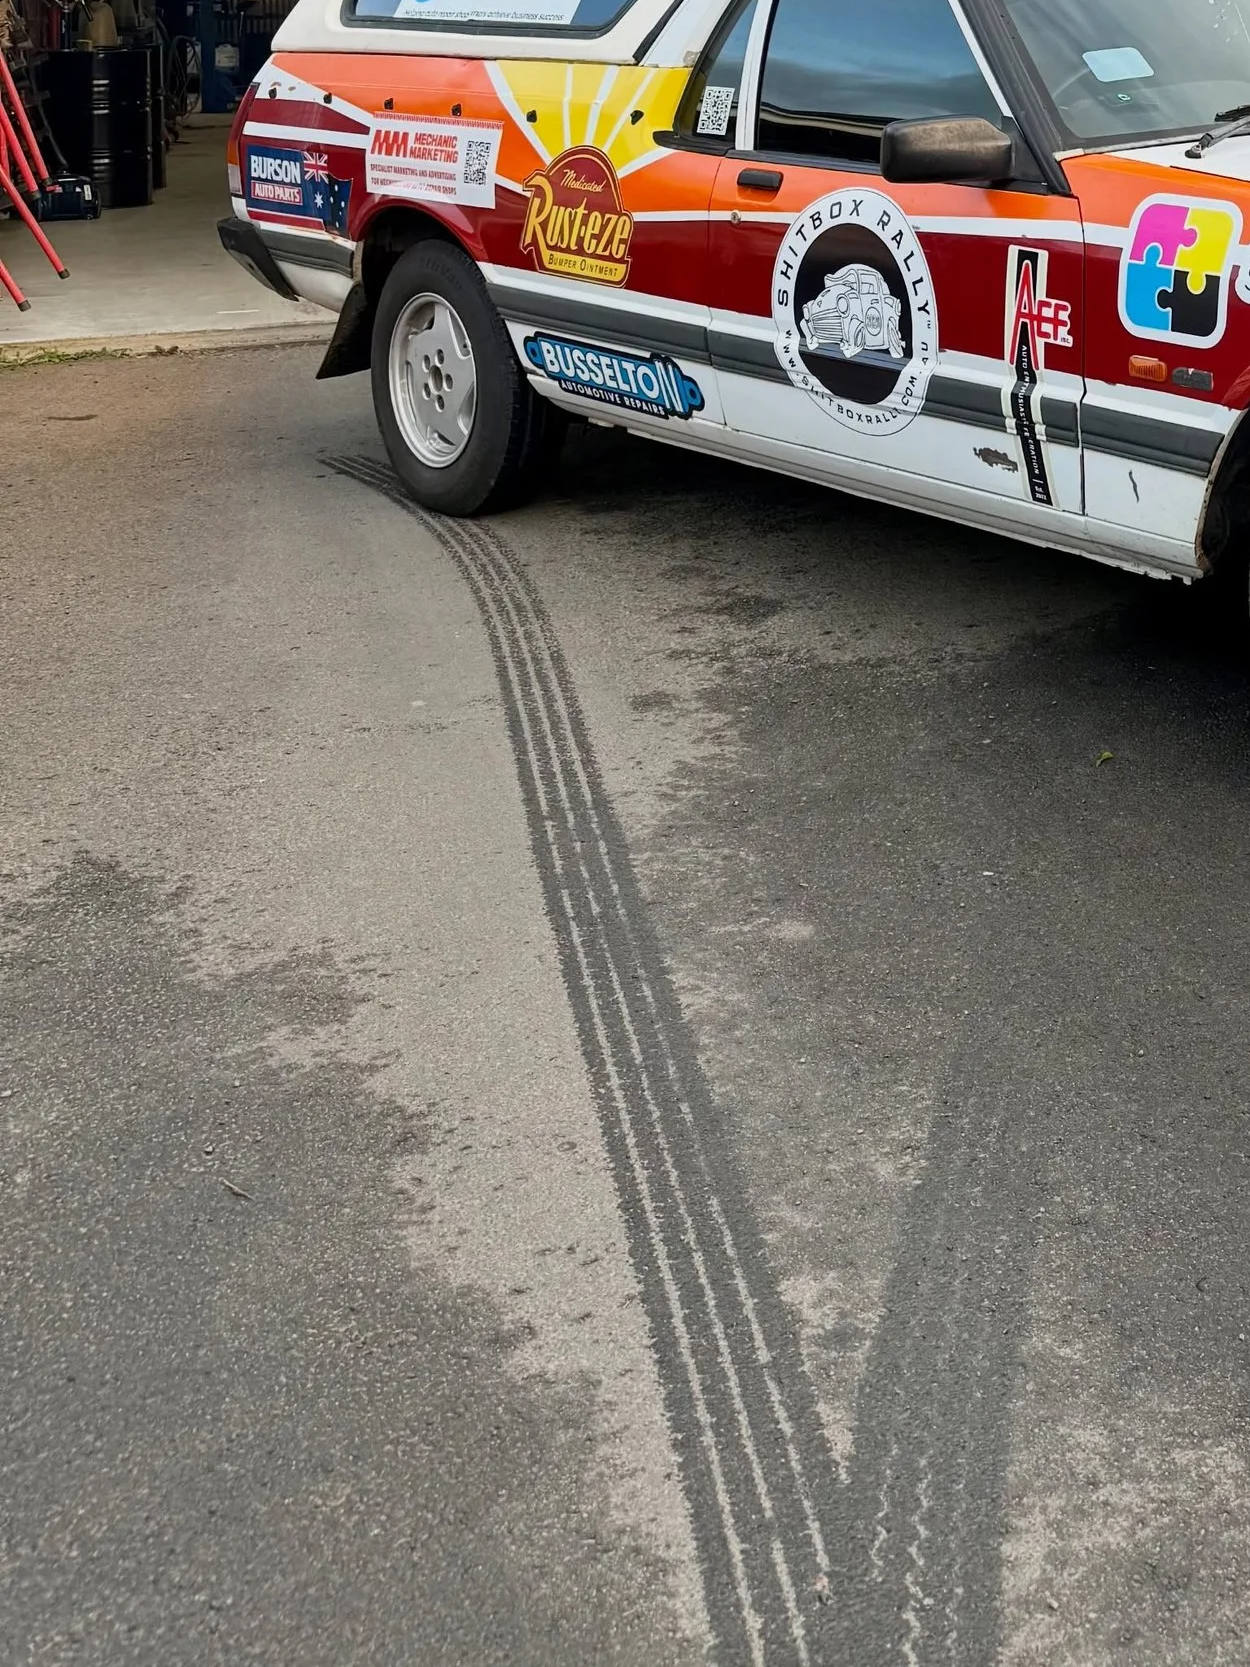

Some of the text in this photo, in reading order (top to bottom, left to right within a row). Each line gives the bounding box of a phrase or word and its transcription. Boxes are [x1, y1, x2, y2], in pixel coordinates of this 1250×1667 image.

[413, 133, 458, 149] MECHANIC
[250, 155, 301, 184] BURSON
[409, 147, 459, 164] MARKETING
[255, 183, 301, 203] AUTO PARTS
[560, 169, 607, 193] Medicated
[777, 199, 931, 316] SHITBOX RALLY
[1021, 345, 1029, 372] AUTO
[540, 341, 684, 413] BUSSELTON
[561, 379, 665, 416] AUTOMOTIVE REPAIRS
[1022, 427, 1040, 475] FEERATION
